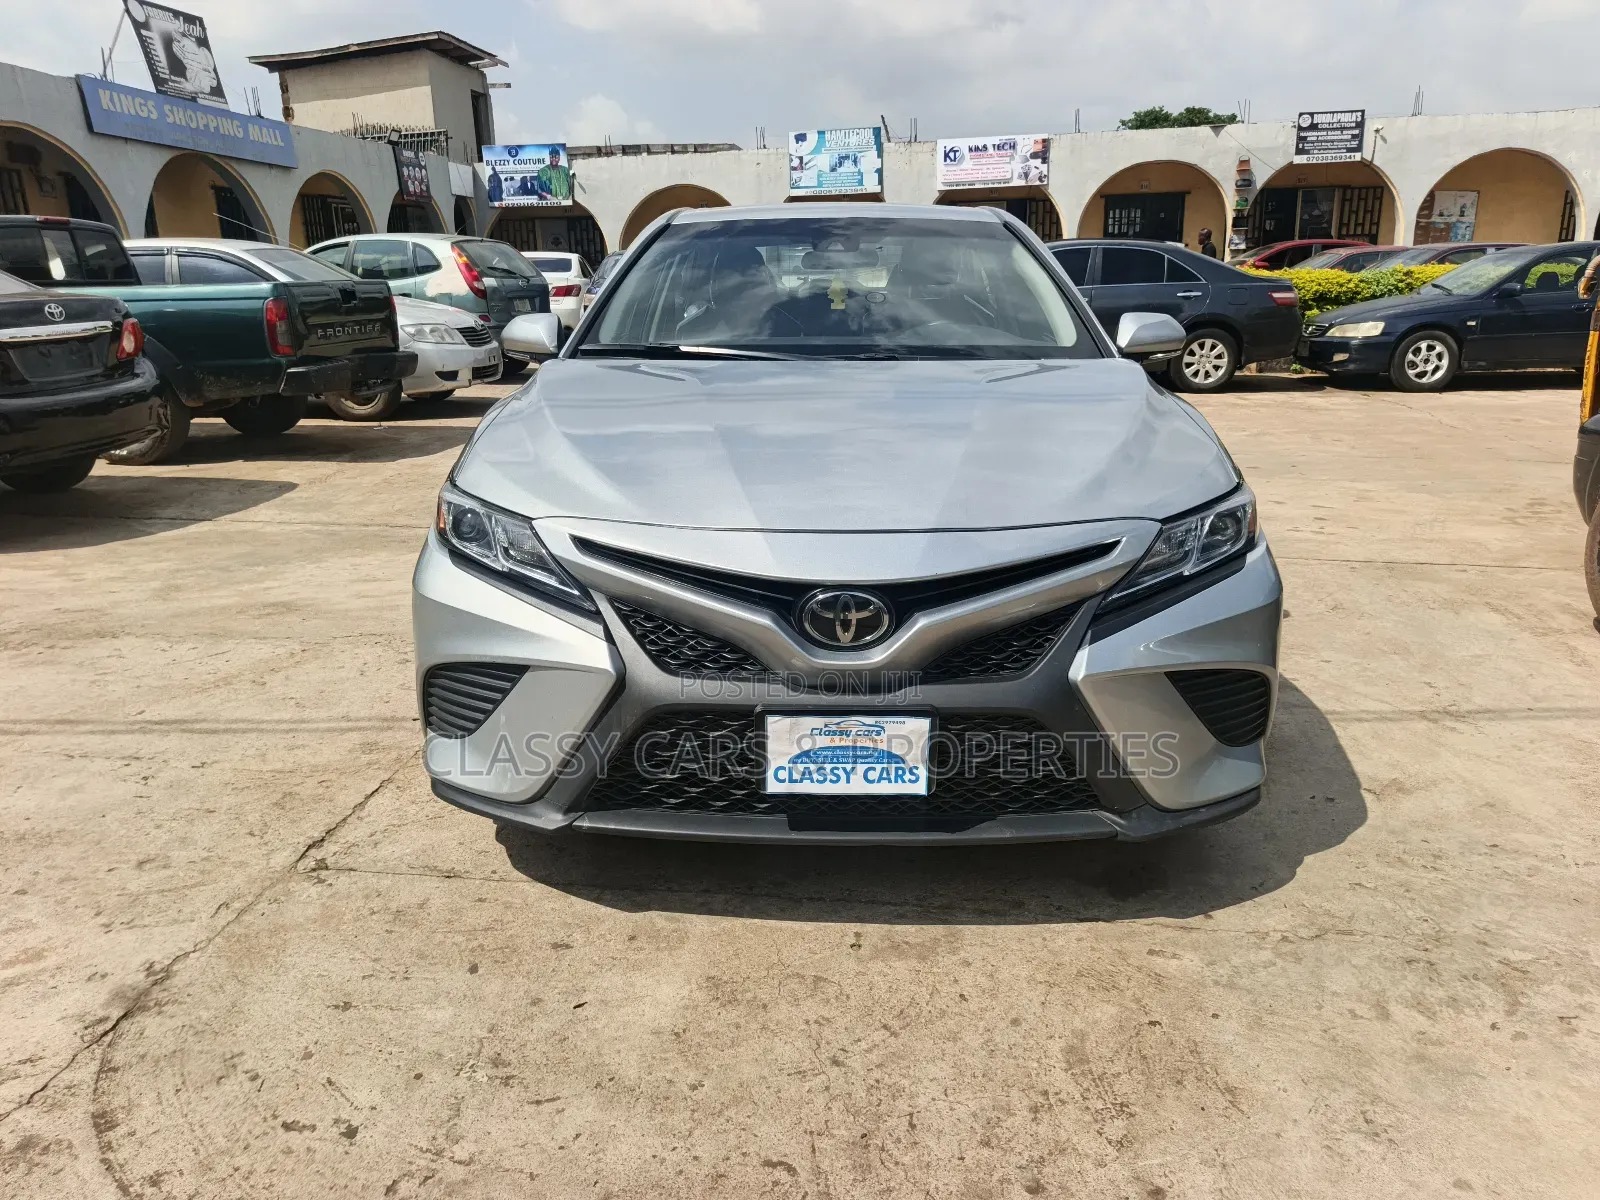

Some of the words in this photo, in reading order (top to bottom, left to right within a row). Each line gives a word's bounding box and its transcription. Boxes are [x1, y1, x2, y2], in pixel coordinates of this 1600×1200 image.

[98, 88, 158, 120] KINGS
[164, 104, 243, 138] SHOPPING
[247, 123, 284, 147] MALL
[826, 139, 875, 147] VENTURES
[992, 141, 1016, 151] TECH
[810, 728, 852, 737] Classy
[855, 728, 882, 736] cars
[773, 765, 856, 784] CLASSY
[863, 765, 920, 784] CARS
